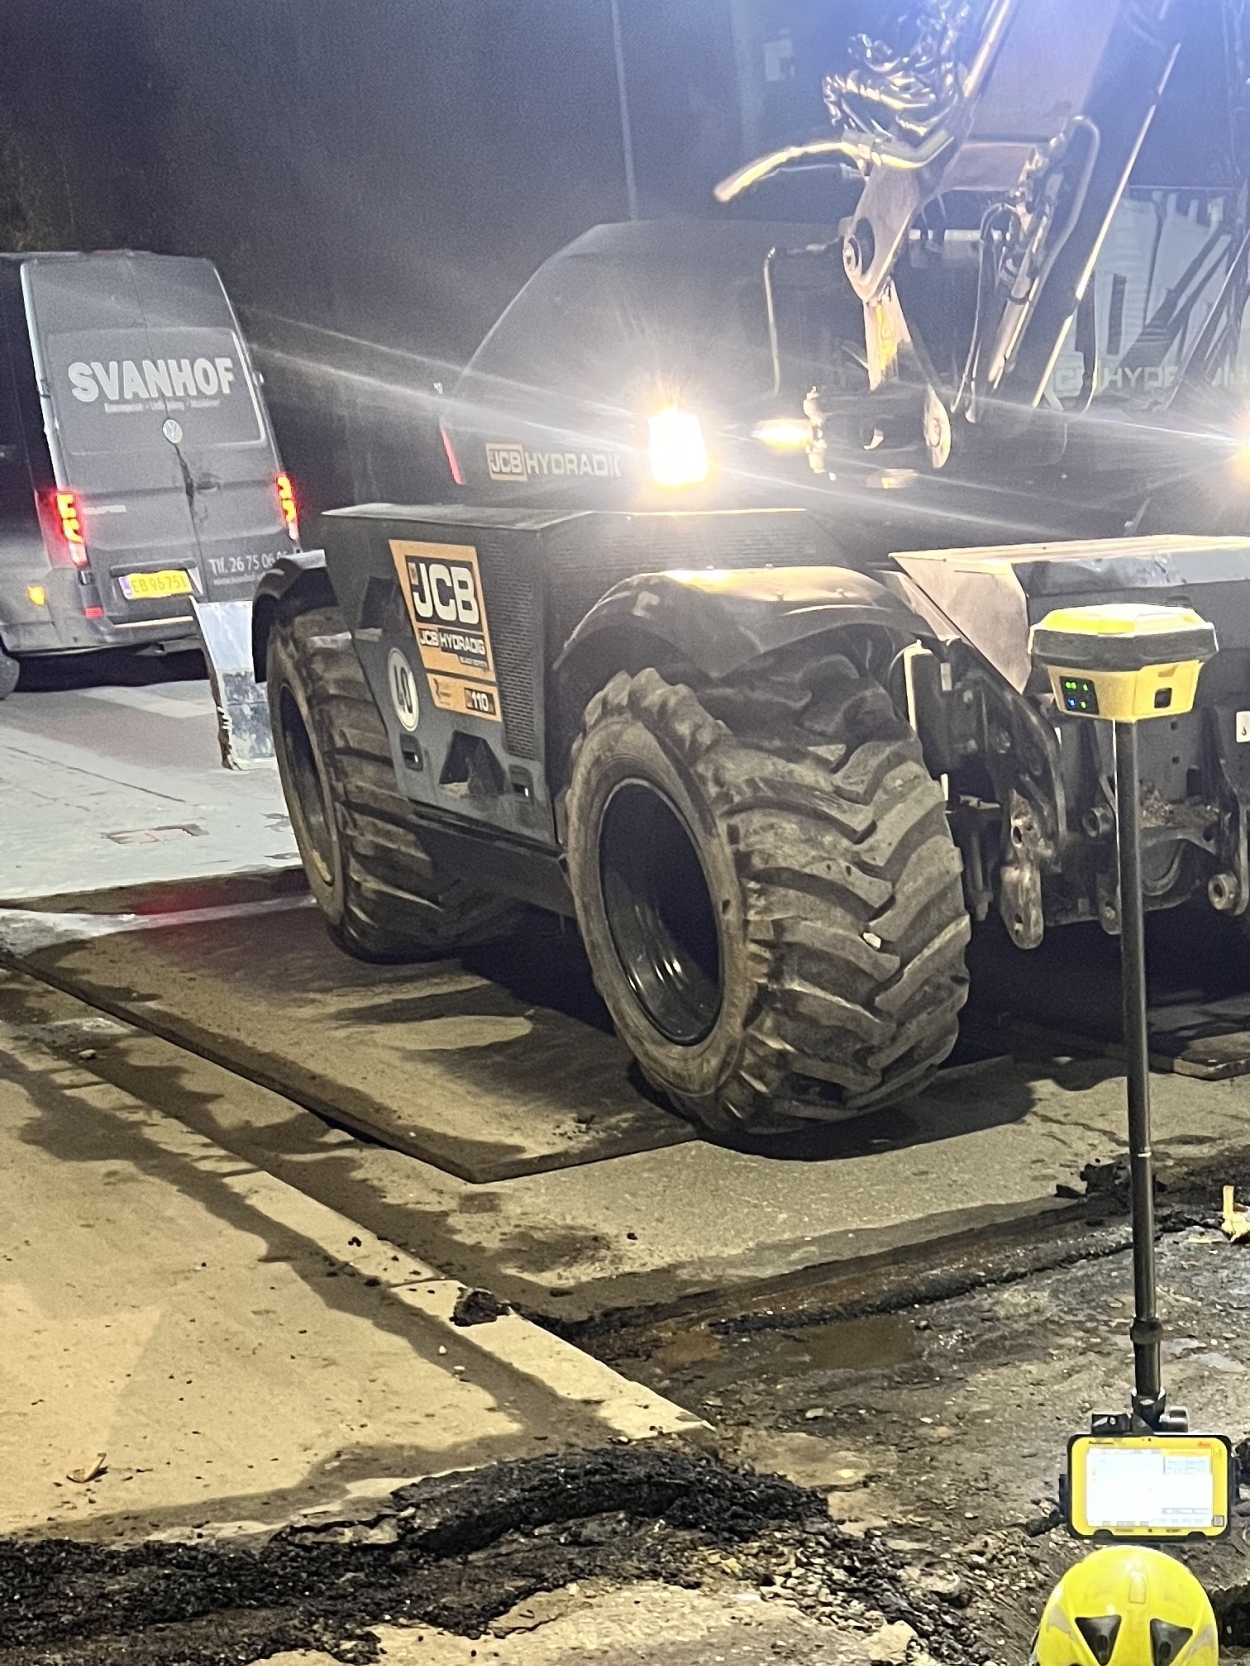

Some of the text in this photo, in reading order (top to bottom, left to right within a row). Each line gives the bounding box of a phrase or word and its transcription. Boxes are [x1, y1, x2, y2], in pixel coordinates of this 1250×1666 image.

[68, 357, 234, 402] SVANHOF
[490, 451, 524, 473] JCB
[229, 557, 245, 572] 26
[246, 554, 260, 571] 75
[411, 562, 480, 625] JCB
[420, 630, 486, 655] JCB HYDRADIG
